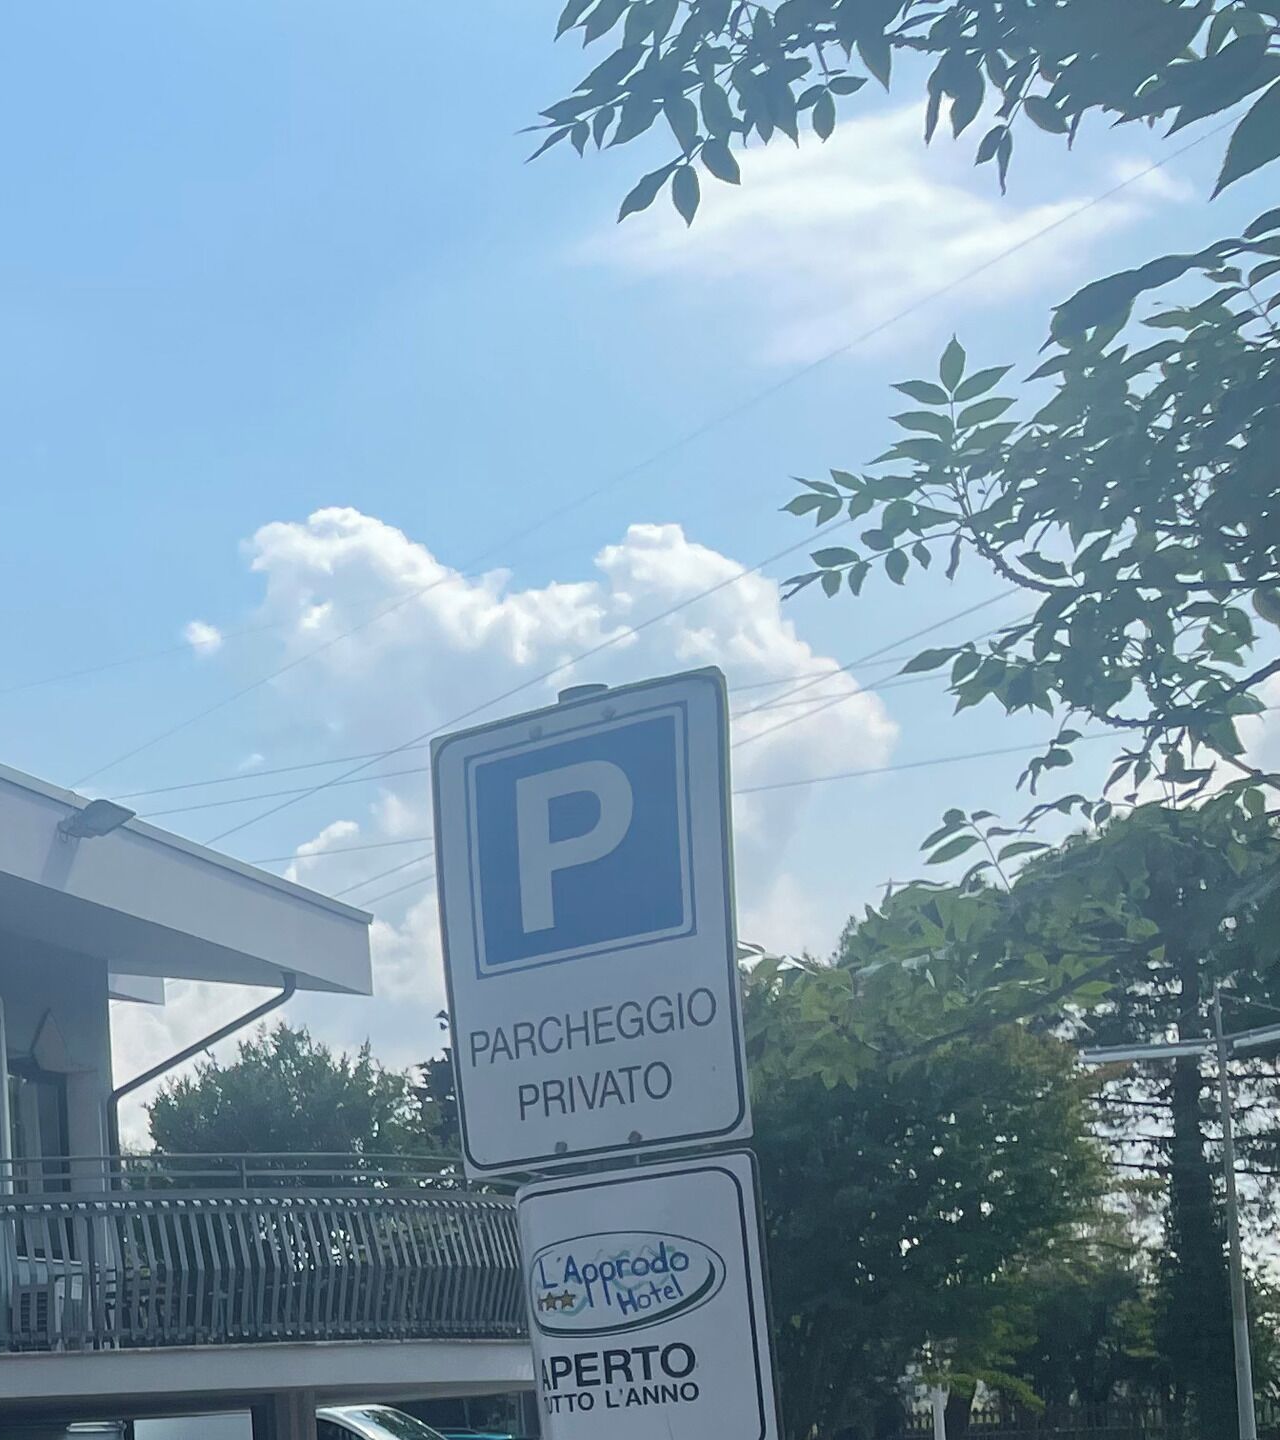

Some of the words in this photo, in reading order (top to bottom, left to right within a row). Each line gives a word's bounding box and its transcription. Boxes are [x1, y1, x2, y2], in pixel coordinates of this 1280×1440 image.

[515, 759, 634, 934] P
[468, 986, 717, 1068] PARCHEGGIO
[517, 1060, 673, 1122] PRIVATO
[539, 1240, 690, 1308] L'Approdo
[616, 1273, 685, 1316] Hotel
[544, 1391, 595, 1414] UTTO
[605, 1382, 700, 1409] L'ANNO
